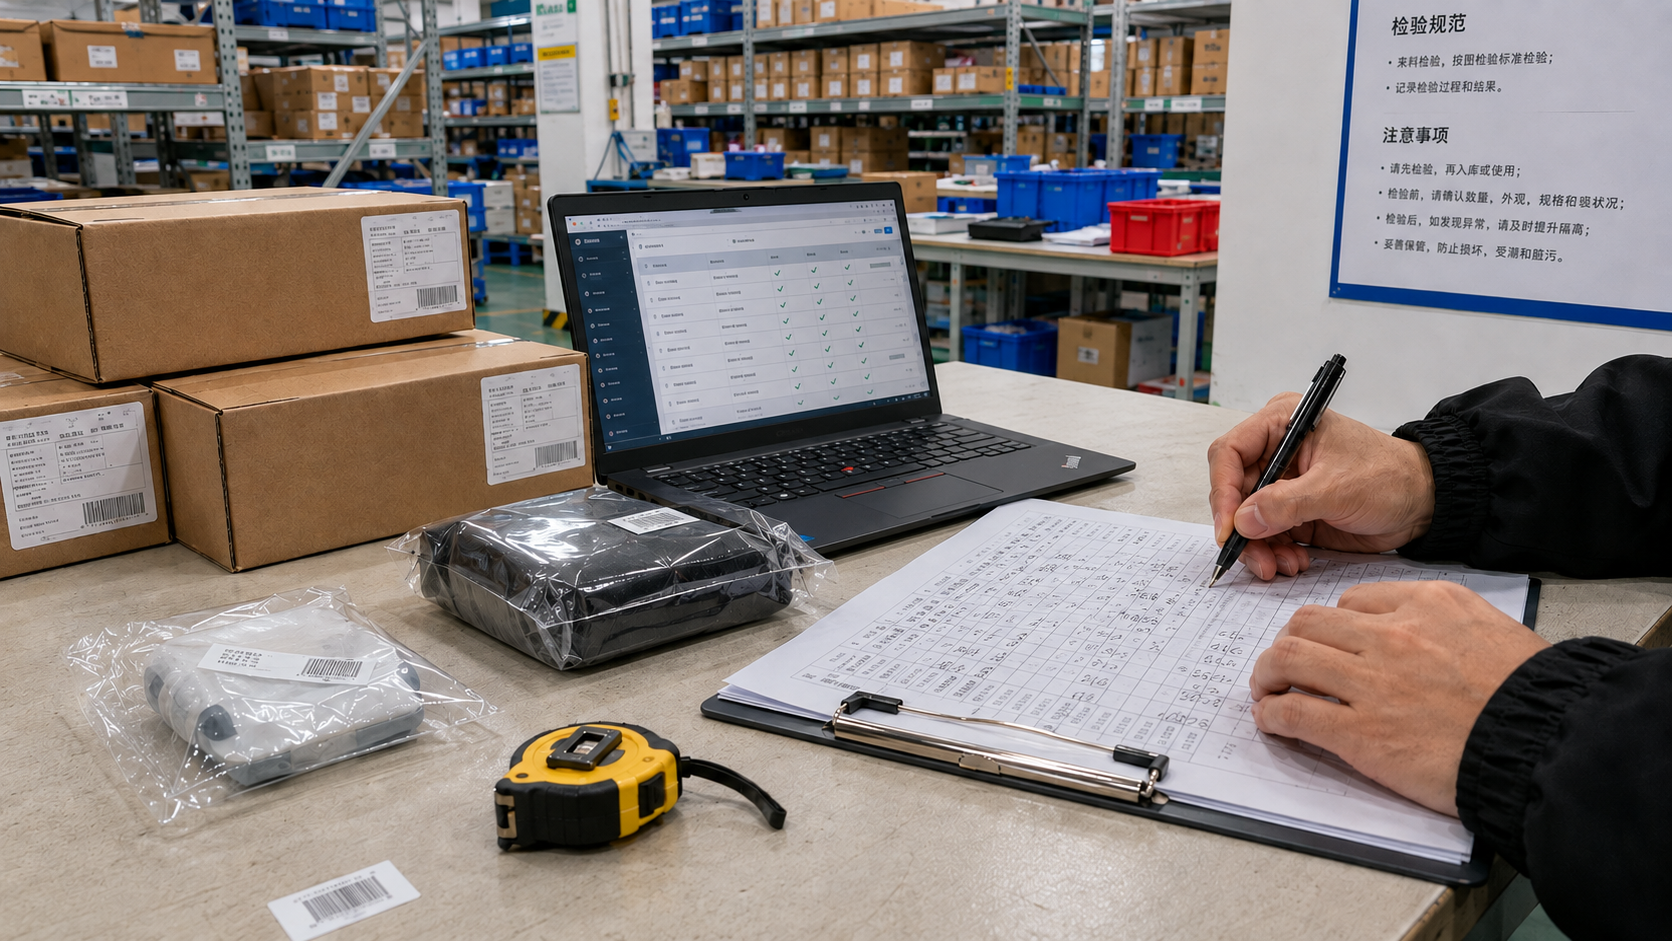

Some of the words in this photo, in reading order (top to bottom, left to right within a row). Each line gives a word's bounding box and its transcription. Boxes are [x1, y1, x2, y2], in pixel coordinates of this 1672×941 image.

[1391, 13, 1467, 36] 检验规范
[1395, 80, 1503, 94] 记录检验过程和结果。
[1382, 126, 1450, 145] 注意事项
